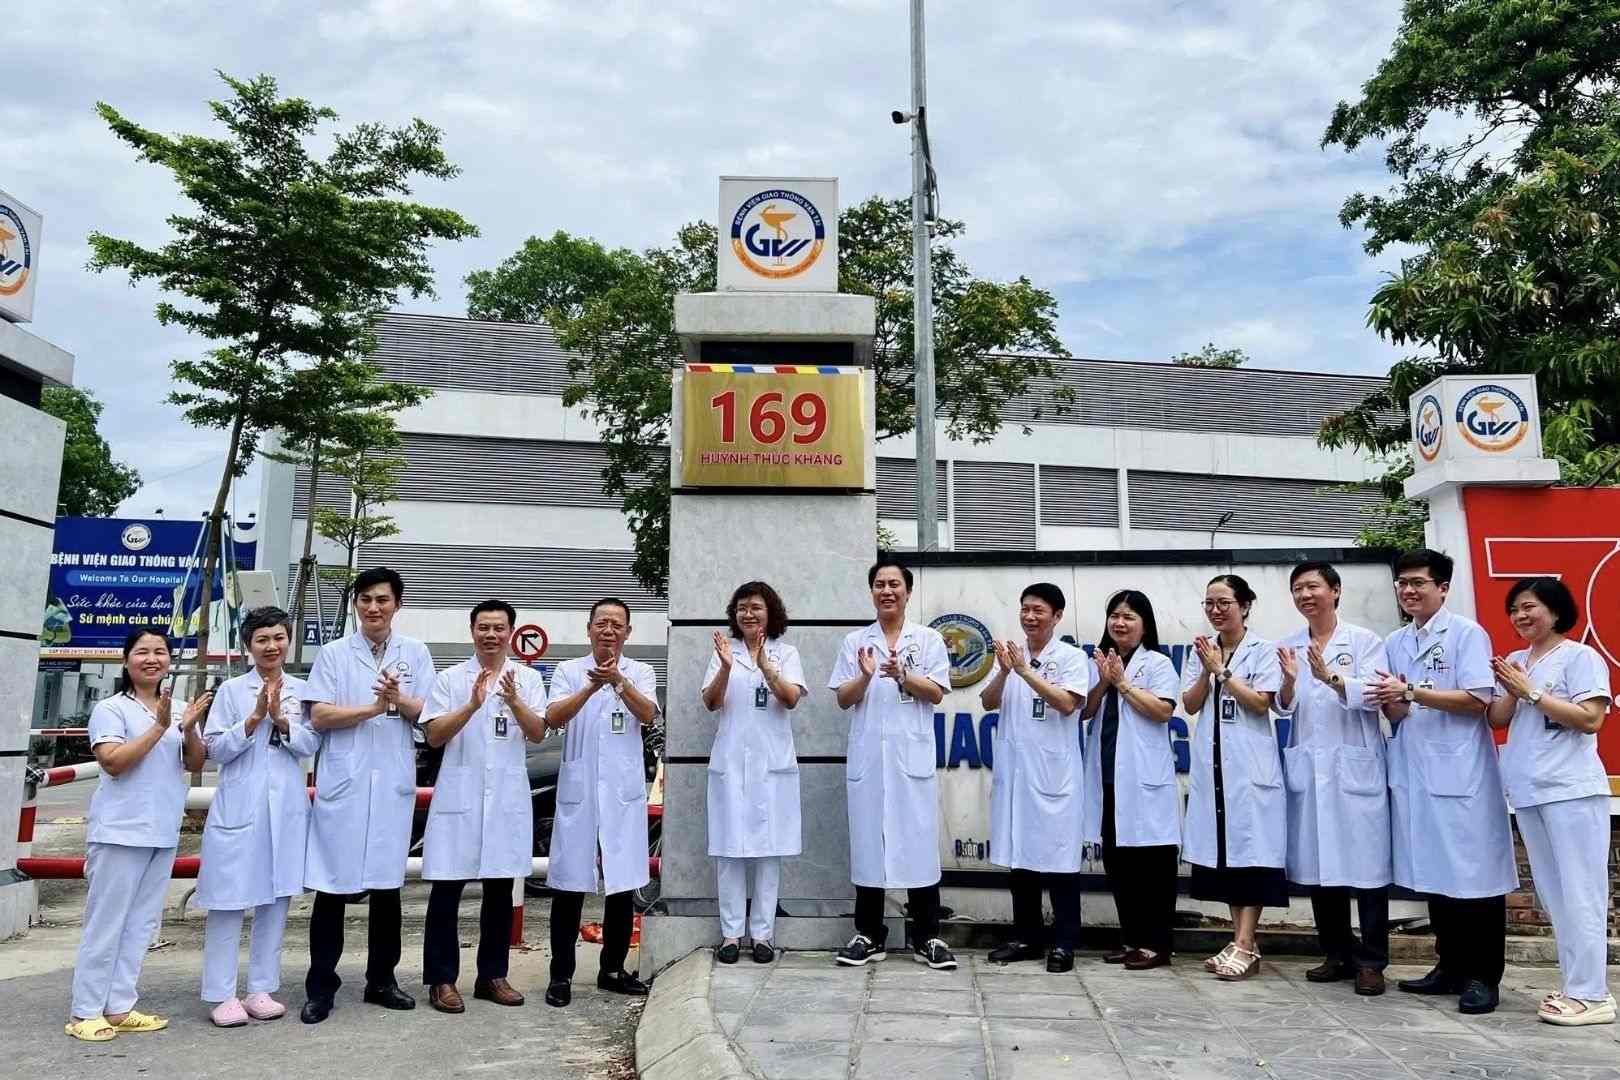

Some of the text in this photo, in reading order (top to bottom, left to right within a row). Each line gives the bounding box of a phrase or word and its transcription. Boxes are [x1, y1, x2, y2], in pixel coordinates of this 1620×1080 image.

[711, 391, 828, 445] 169
[50, 552, 80, 567] BỆNH
[82, 553, 107, 567] VIỆN
[110, 555, 136, 567] GIAO
[140, 554, 175, 568] THÔNG
[80, 573, 183, 585] Welcome To Our Hospital
[96, 613, 125, 626] mệnh
